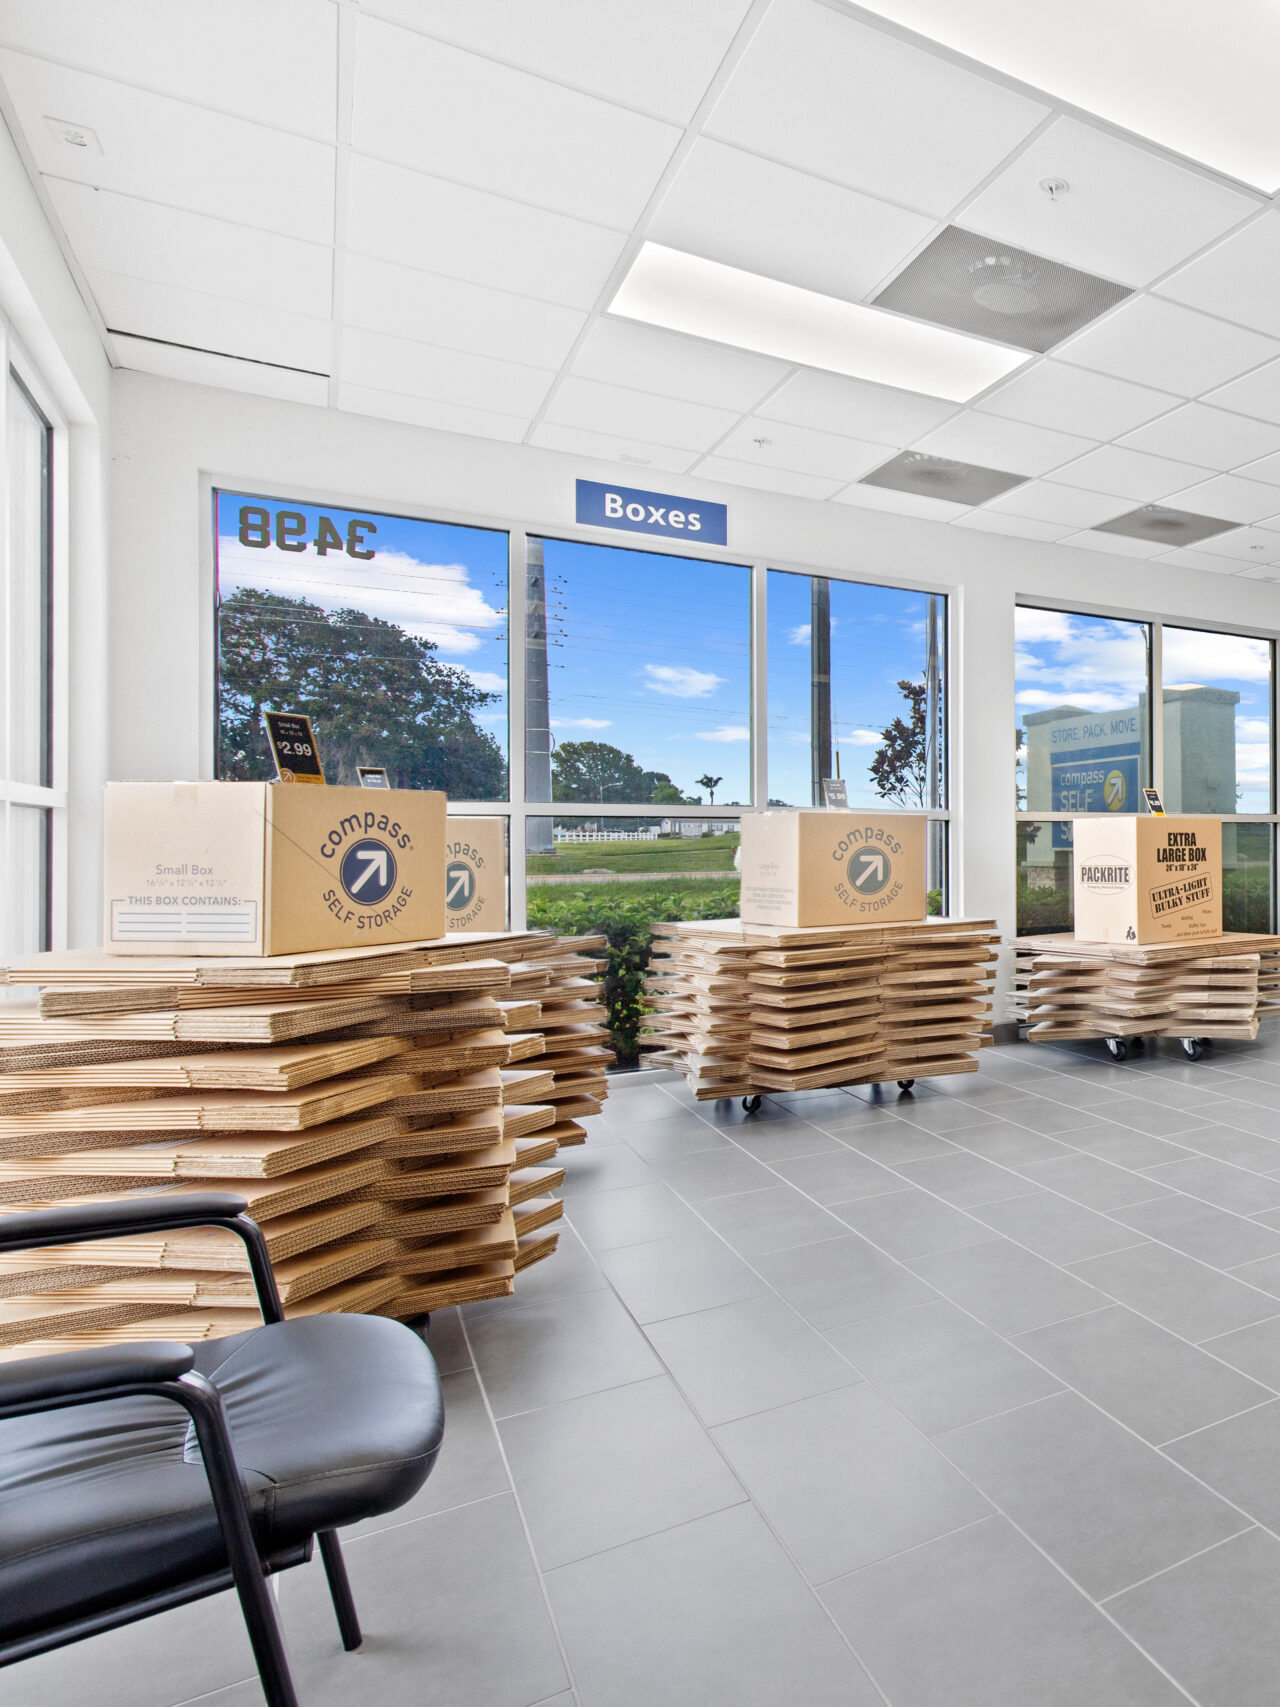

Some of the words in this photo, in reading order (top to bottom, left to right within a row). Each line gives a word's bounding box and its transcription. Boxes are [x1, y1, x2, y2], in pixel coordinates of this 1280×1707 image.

[604, 492, 702, 531] Boxes
[1051, 727, 1080, 744] STORE.
[1083, 723, 1108, 739] PACK.
[1110, 717, 1138, 735] MOVE.
[276, 741, 312, 757] $2.99
[1060, 770, 1105, 789] compass
[1060, 789, 1094, 812] SELF
[320, 811, 411, 859] compass
[832, 826, 902, 862] compass
[1167, 832, 1197, 847] EXTRA
[446, 841, 485, 869] pass
[1156, 847, 1187, 863] LARGE
[1188, 847, 1207, 862] BOX
[155, 864, 188, 876] Small
[191, 864, 214, 876] Box
[1081, 866, 1130, 883] PACKRITE
[128, 895, 153, 905] THIS
[155, 896, 179, 905] BOX
[181, 896, 242, 906] CONTAINS:
[834, 882, 858, 908] SELF
[859, 880, 903, 913] STORAGE
[1152, 877, 1208, 903] ULTRA-LIGHT
[1154, 895, 1183, 914] BULKY
[1185, 887, 1210, 904] STUFF
[322, 889, 355, 924] SELF
[356, 885, 413, 929] STORAGE
[449, 895, 486, 929] STORAGE
